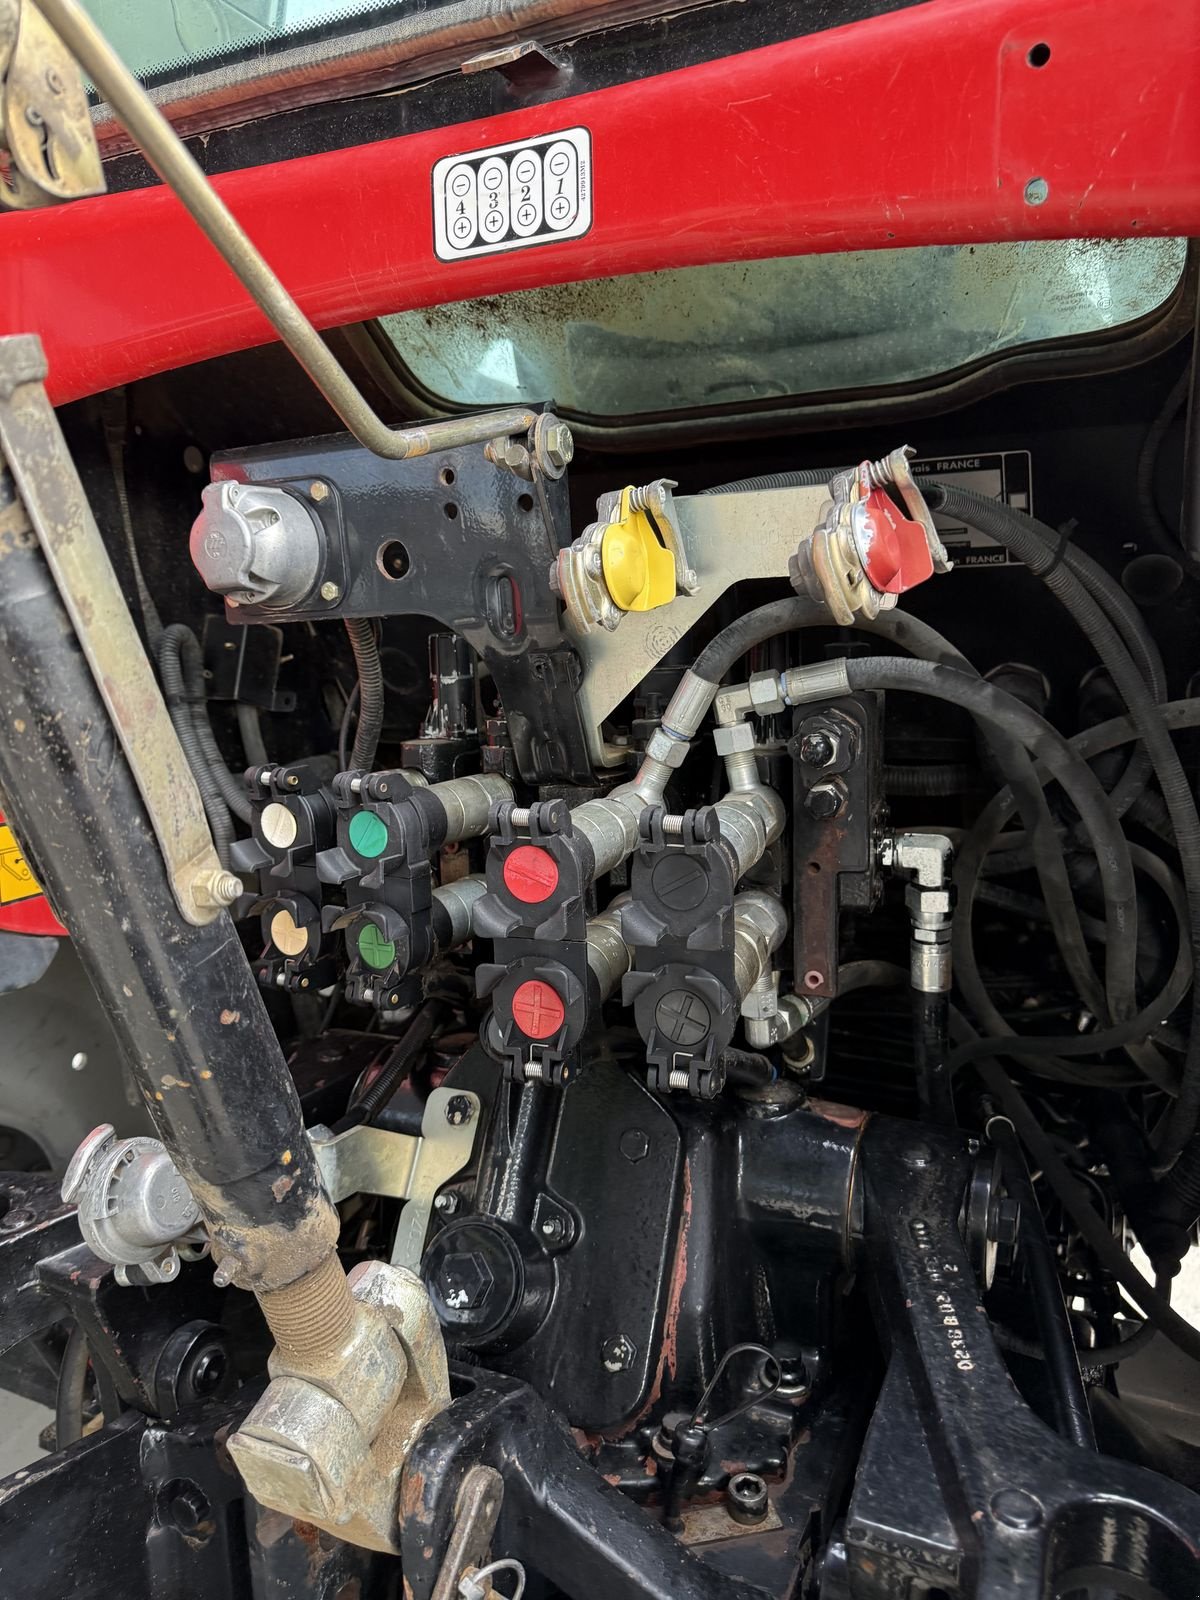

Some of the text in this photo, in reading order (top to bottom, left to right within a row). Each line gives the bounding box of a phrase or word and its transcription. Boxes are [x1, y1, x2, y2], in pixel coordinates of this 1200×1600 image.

[456, 178, 564, 215] 4 3 2 1
[936, 459, 980, 471] FRANCE
[965, 554, 1005, 564] FRANCE
